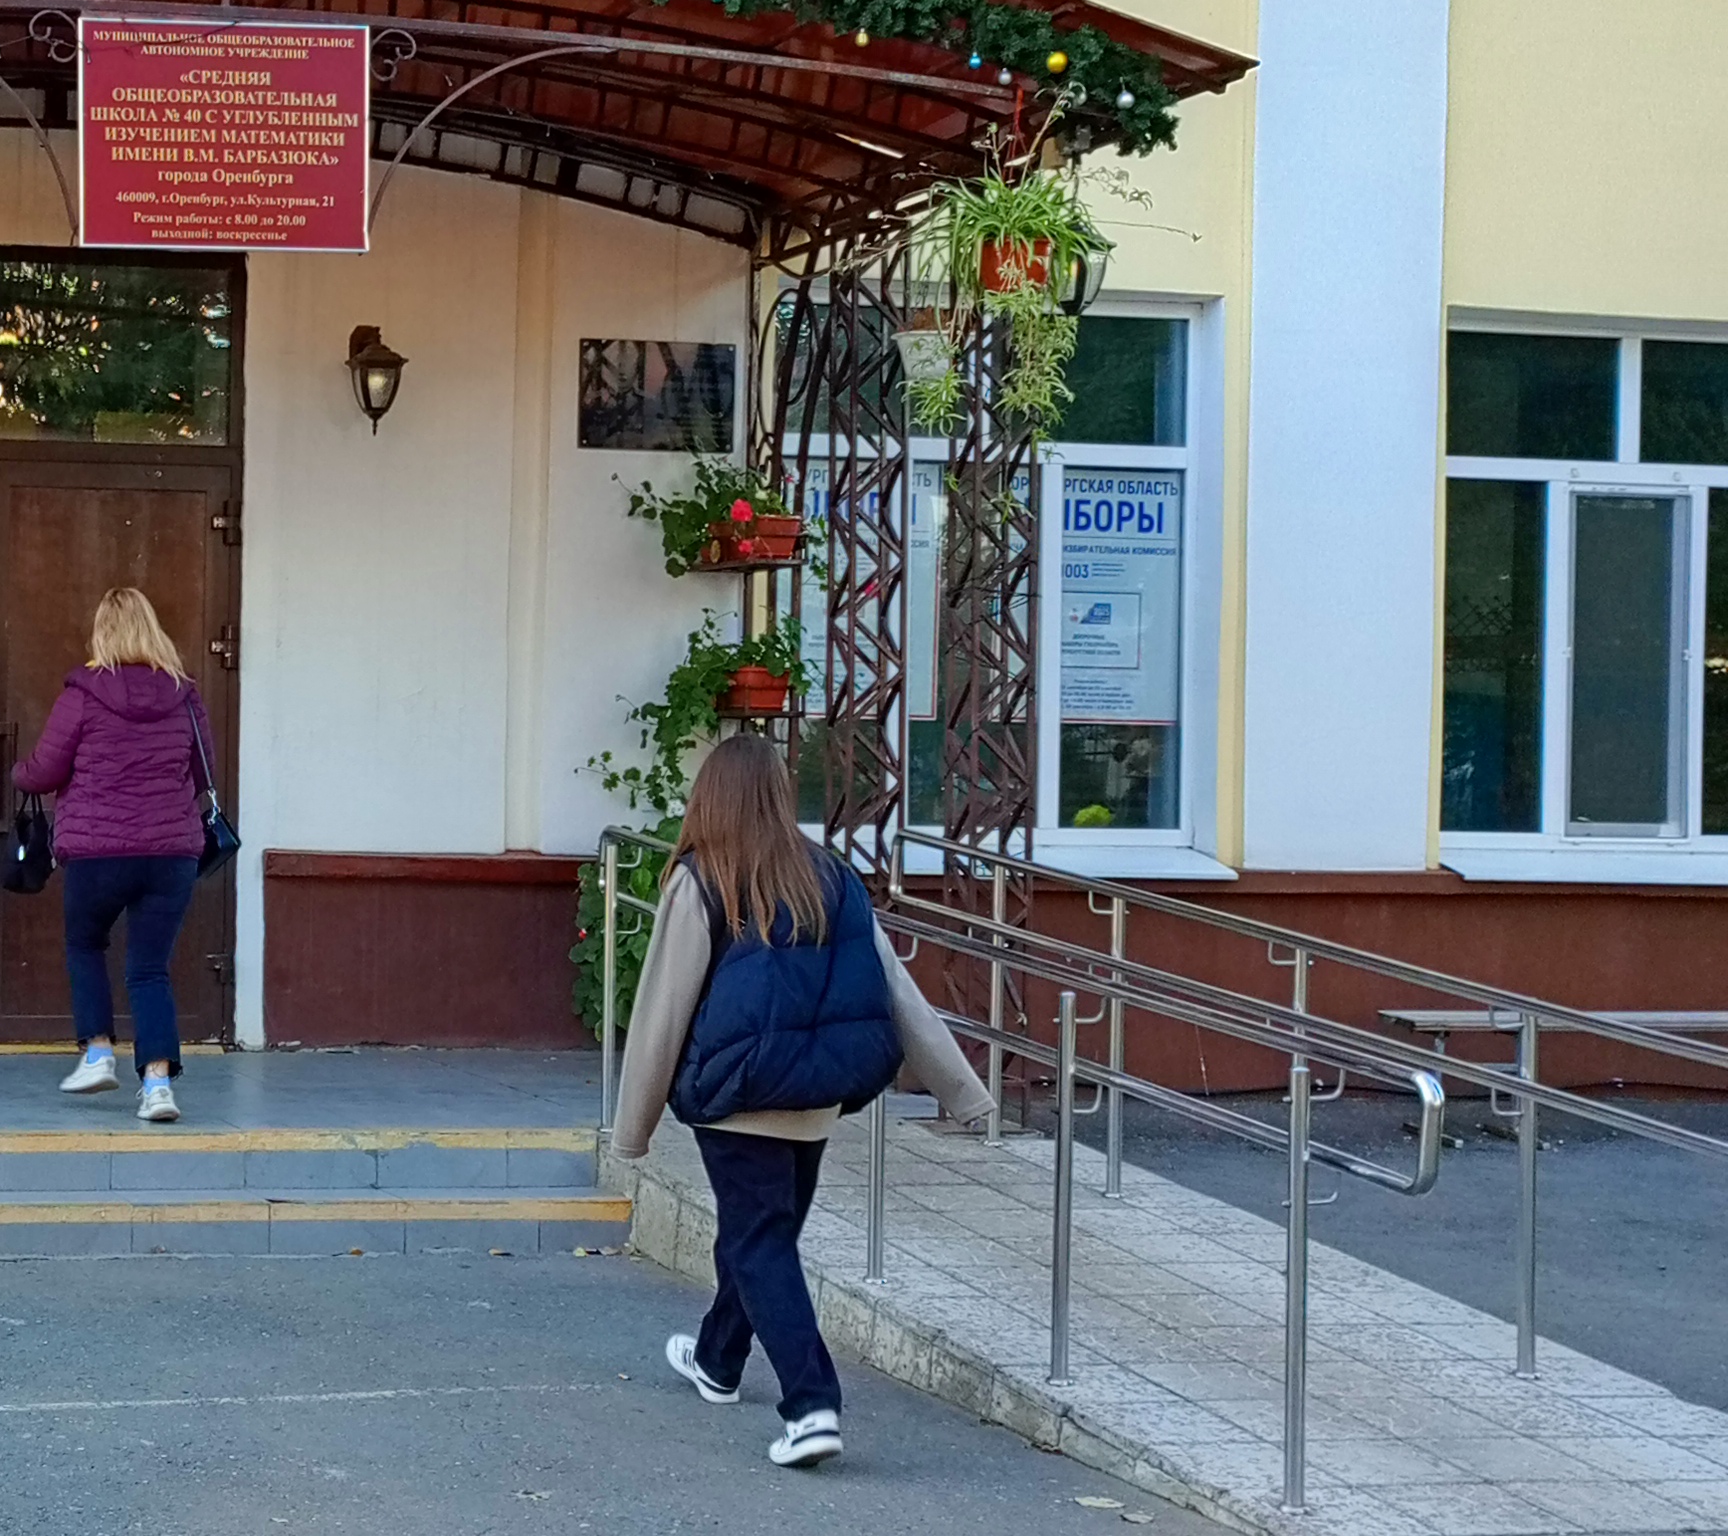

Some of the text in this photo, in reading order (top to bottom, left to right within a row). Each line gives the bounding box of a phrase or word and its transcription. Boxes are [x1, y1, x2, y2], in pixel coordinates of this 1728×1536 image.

[93, 31, 355, 48] МУНИЦИПАЛЬНОЕ ОБЩЕОБРАЗОВАТЕЛЬНОЕ
[140, 44, 309, 59] АВТОНОМНОЕ УЧРЕЖДЕНИЕ
[180, 70, 271, 86] «СРЕДНЯЯ
[112, 87, 337, 107] ОБЩЕОБРАЗОВАТЕЛЬНАЯ
[91, 107, 358, 127] ШКОЛА № 40 С УГЛУБЛЕННЫМ
[105, 127, 345, 146] ИЗУЧЕНИЕМ МАТЕМАТИКИ
[111, 147, 339, 165] ИМЕНИ В.М. БАРБАЗЮКА»
[158, 169, 293, 186] города Оренбурга
[116, 192, 334, 208] 460009, г.Оренбург, ул.Культурная, 21
[133, 212, 306, 227] Режим работы: с 8.00 до 20.00
[152, 228, 287, 240] выходной: воскресенье
[1063, 477, 1178, 496] РГСКАЯ ОБЛАСТЬ
[1064, 498, 1163, 534] БОРЫ
[1132, 546, 1177, 557] КОМИССИЯ
